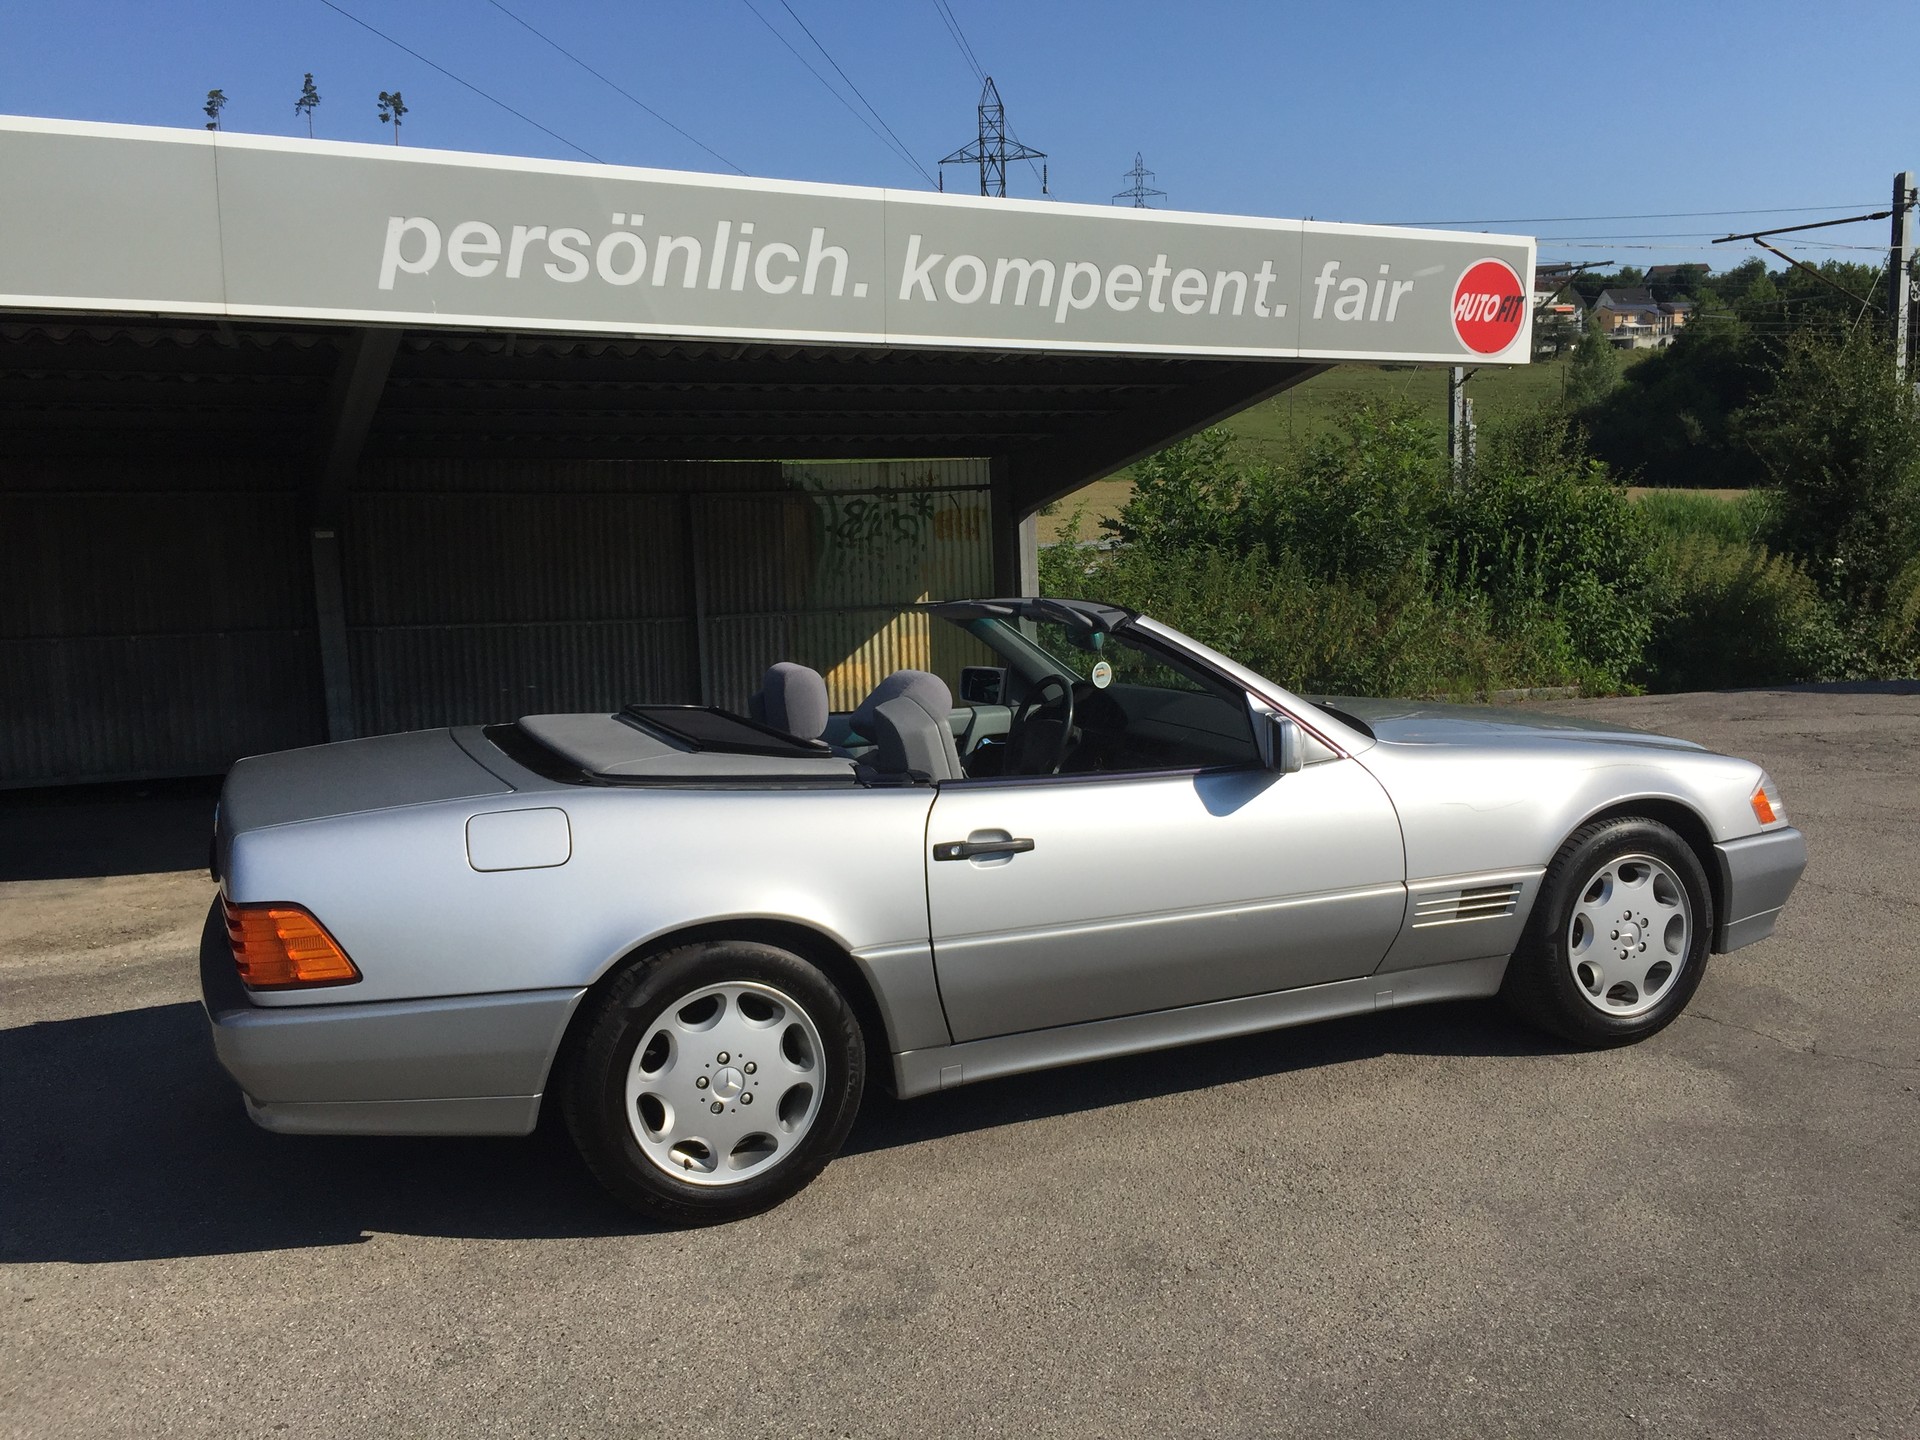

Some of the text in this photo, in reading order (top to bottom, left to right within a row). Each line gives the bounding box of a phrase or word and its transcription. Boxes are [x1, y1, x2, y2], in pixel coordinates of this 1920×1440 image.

[378, 213, 1414, 323] persönlich. kompetent. fair
[1454, 292, 1525, 322] AUTOFIT
